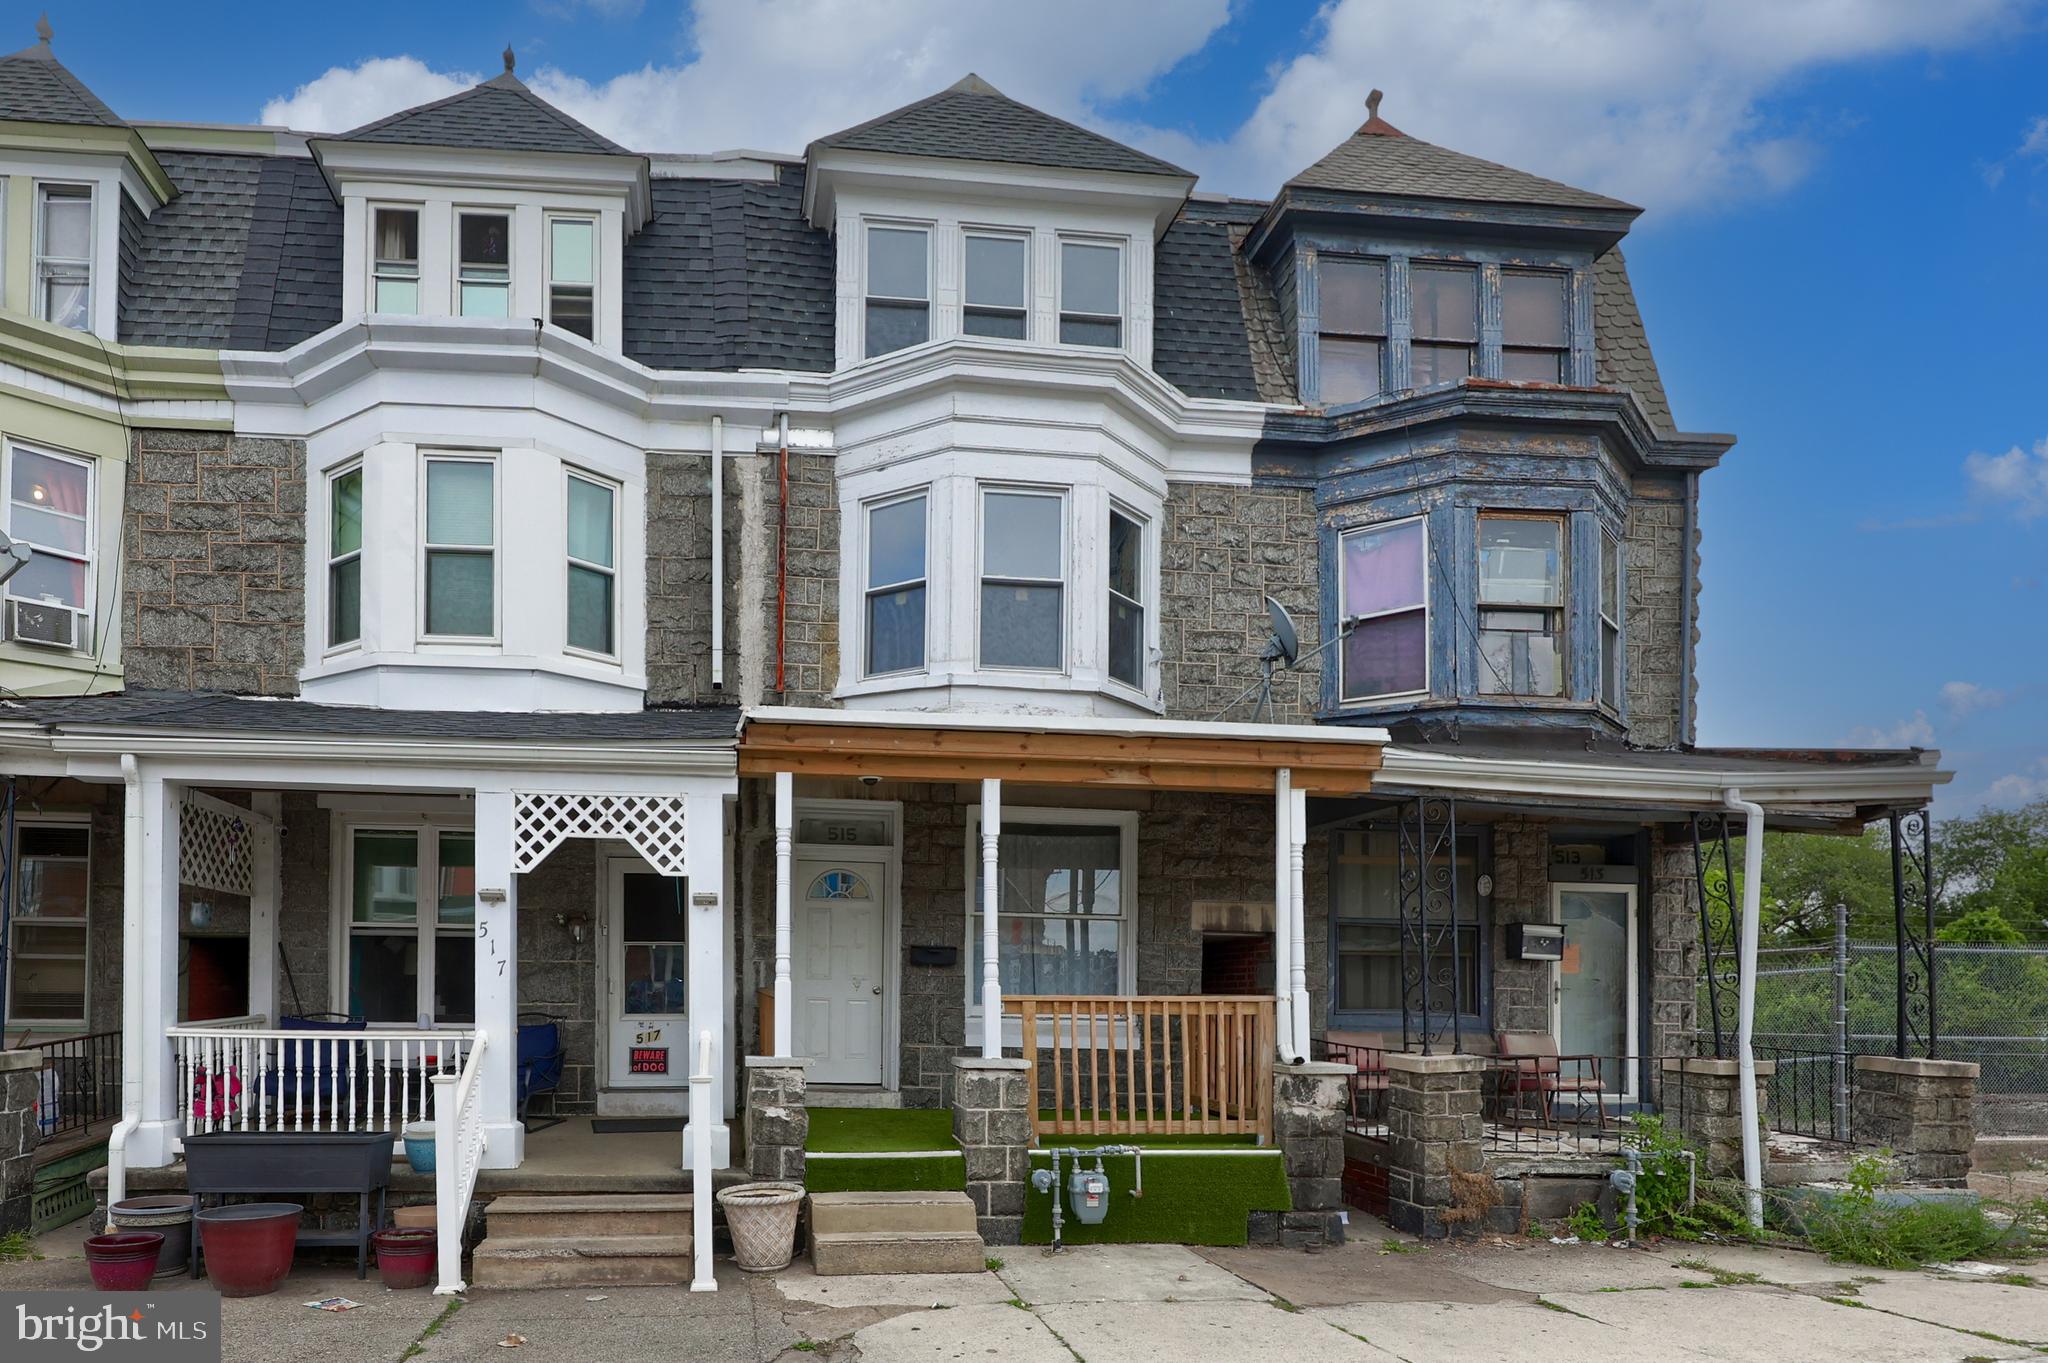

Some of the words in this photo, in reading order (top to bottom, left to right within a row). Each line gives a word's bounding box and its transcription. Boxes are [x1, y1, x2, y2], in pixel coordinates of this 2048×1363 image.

[828, 827, 857, 841] 515
[479, 921, 506, 976] 517
[636, 1029, 661, 1044] 517
[633, 1050, 665, 1060] BEWARE
[633, 1062, 642, 1072] of
[643, 1063, 665, 1072] DOG
